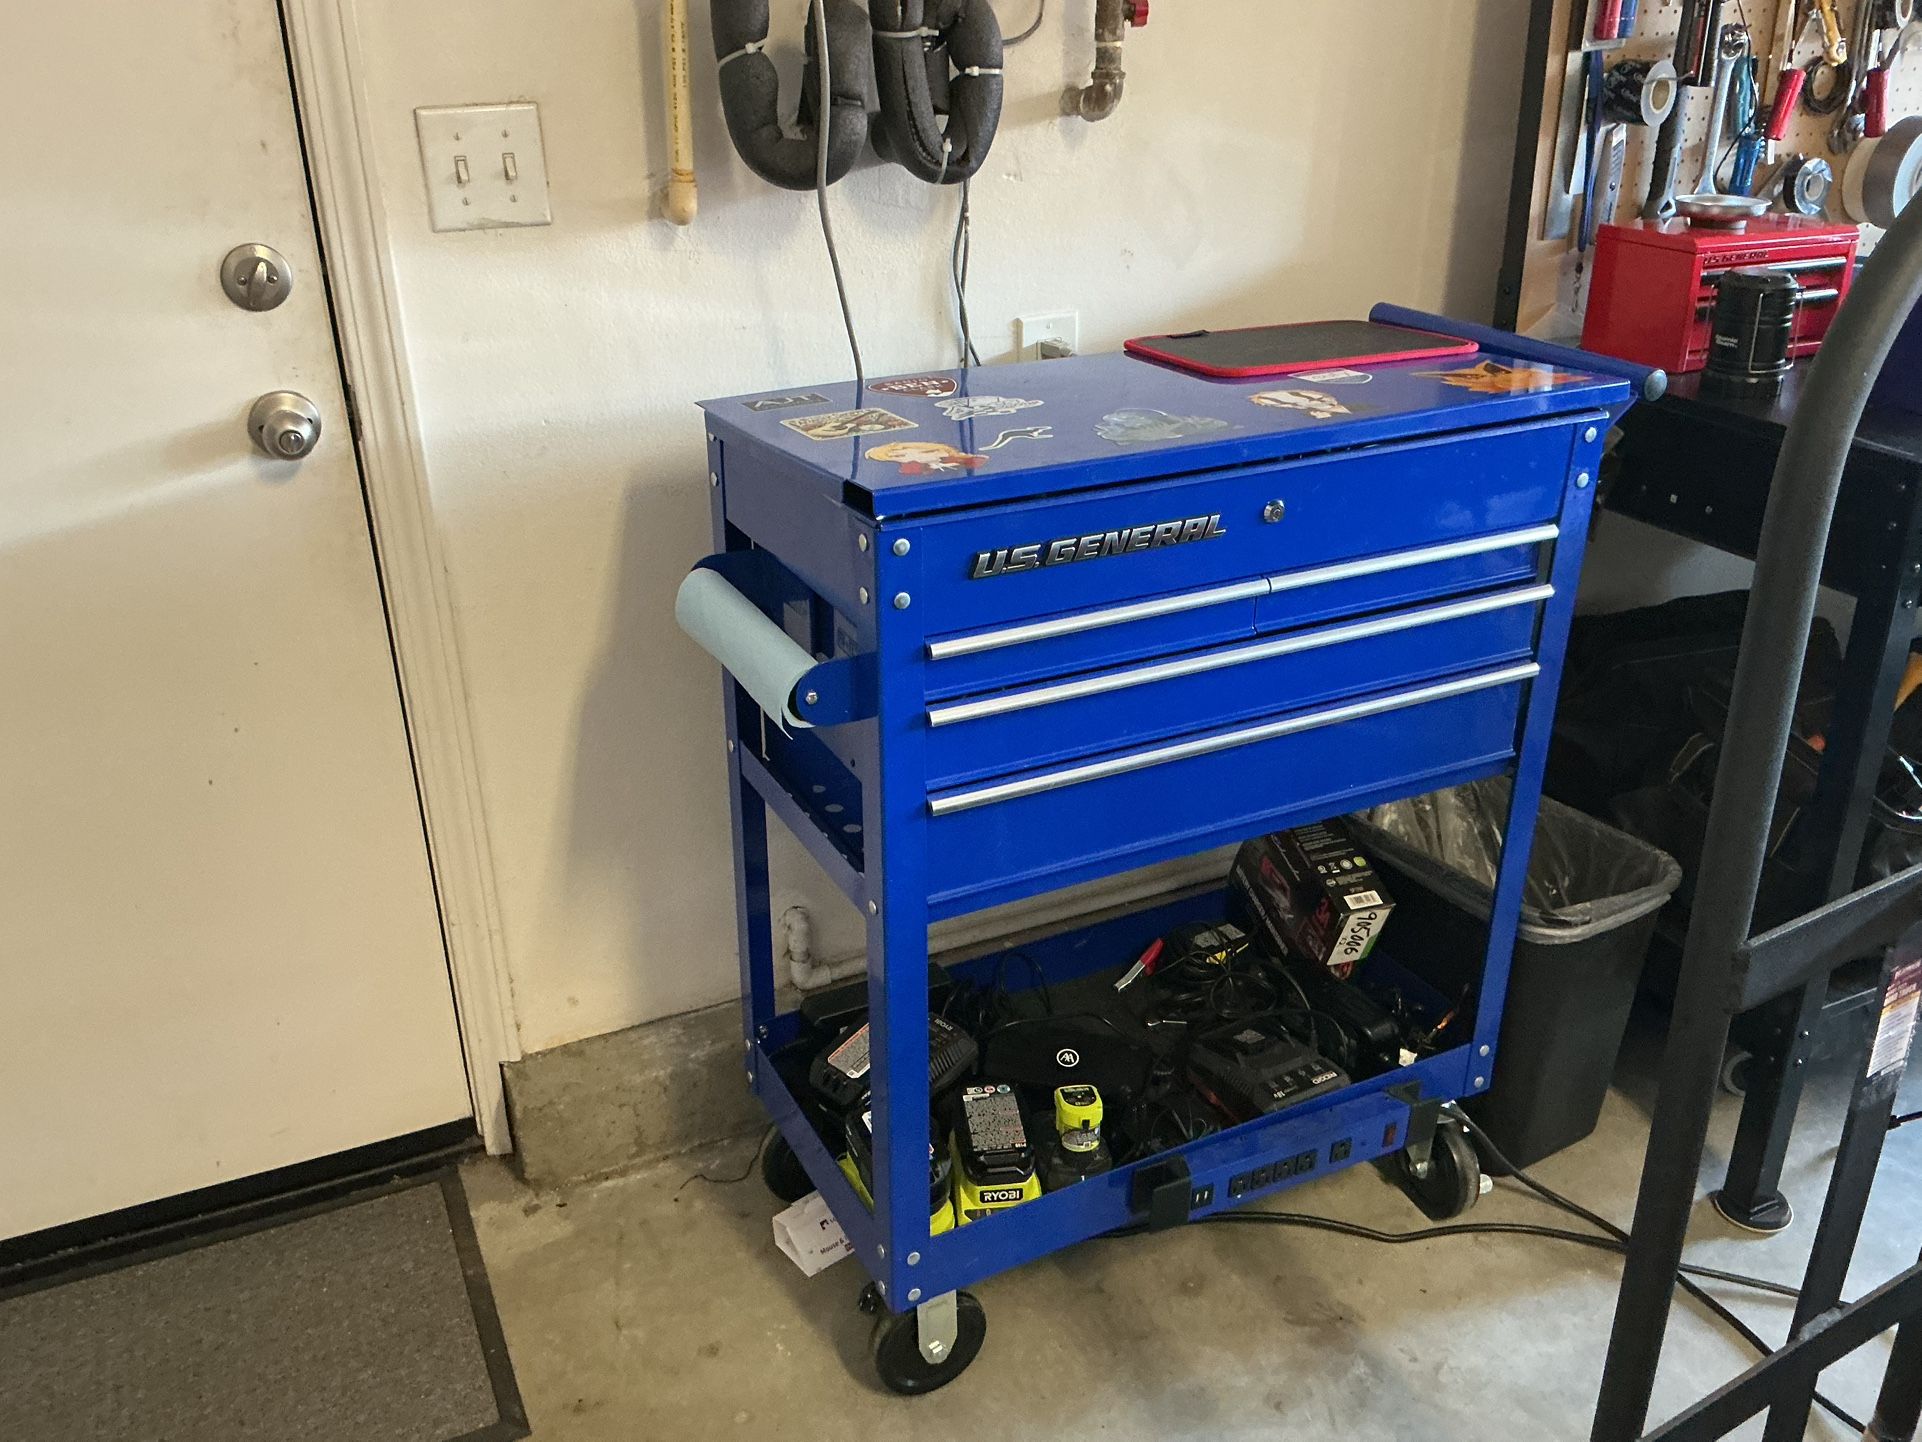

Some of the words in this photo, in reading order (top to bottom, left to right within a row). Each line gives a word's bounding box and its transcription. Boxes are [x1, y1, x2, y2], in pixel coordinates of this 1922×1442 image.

[973, 544, 1041, 579] U.S.
[1045, 514, 1227, 566] GENERAL
[1343, 911, 1377, 955] 905006
[934, 1018, 953, 1031] RYOBI
[983, 1190, 1021, 1201] RYOBI
